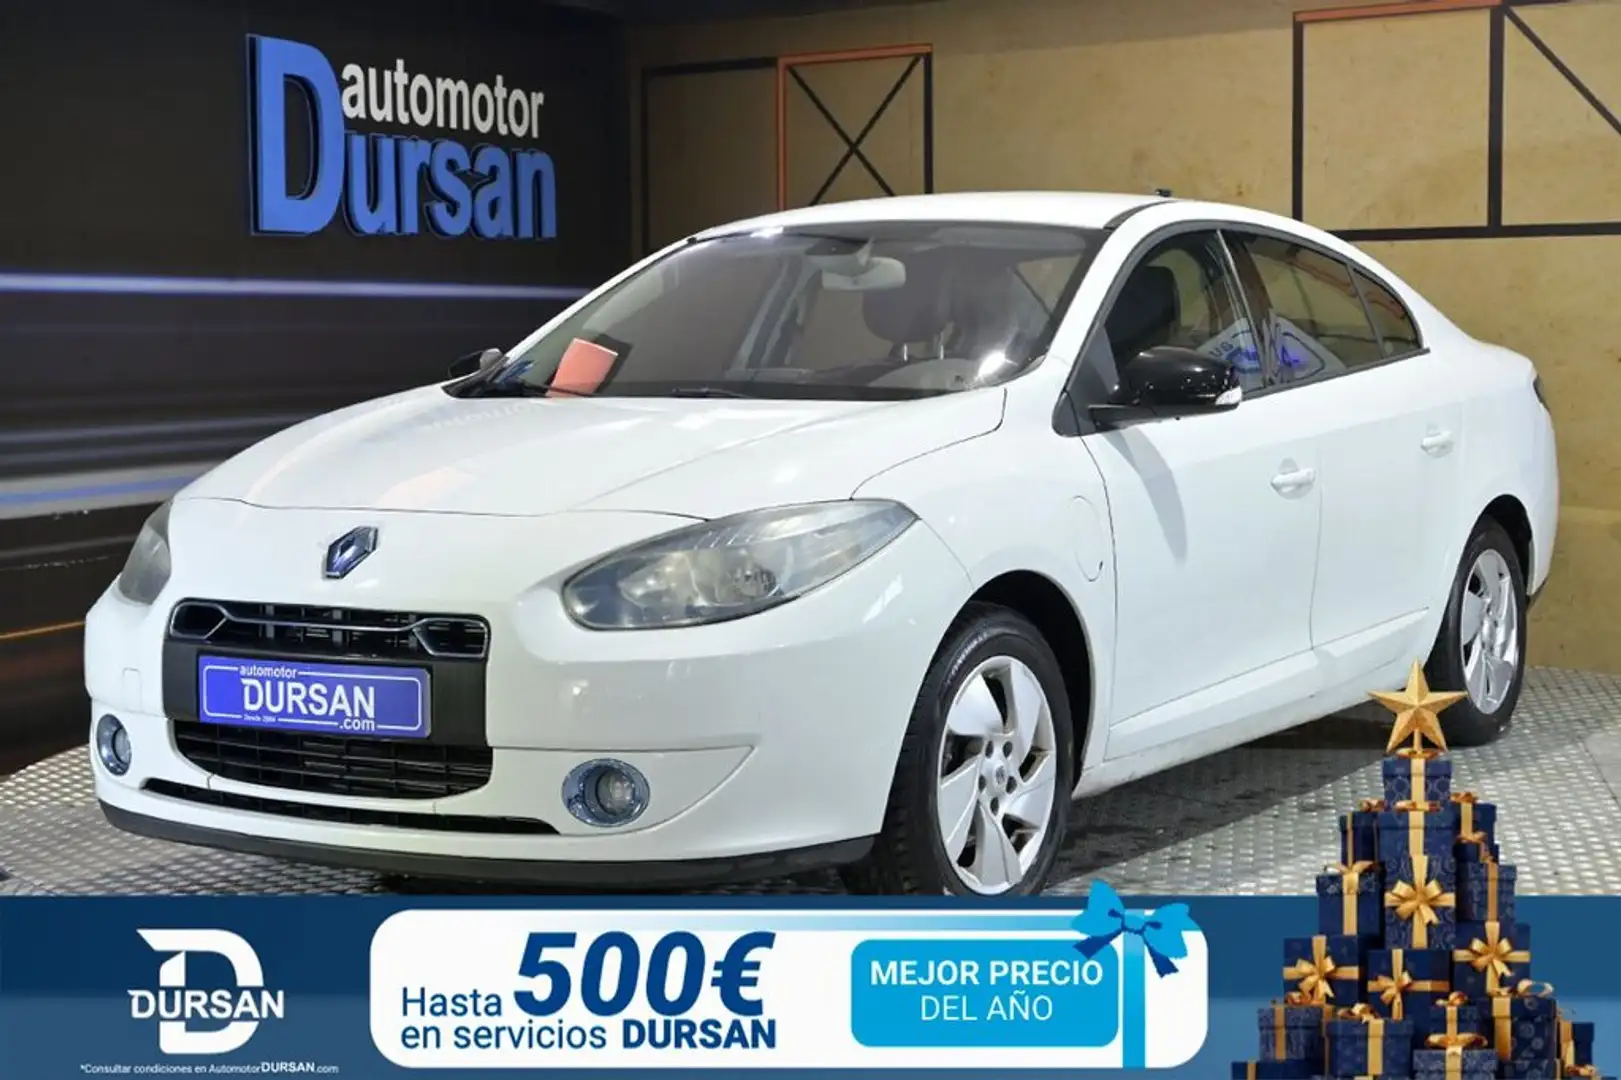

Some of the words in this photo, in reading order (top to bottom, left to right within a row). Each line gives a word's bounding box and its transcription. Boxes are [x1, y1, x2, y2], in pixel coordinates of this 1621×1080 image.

[341, 58, 544, 138] automotor
[246, 34, 556, 239] Dursan
[240, 665, 297, 678] automotor
[241, 678, 375, 718] DURSAN
[339, 718, 375, 731] .com
